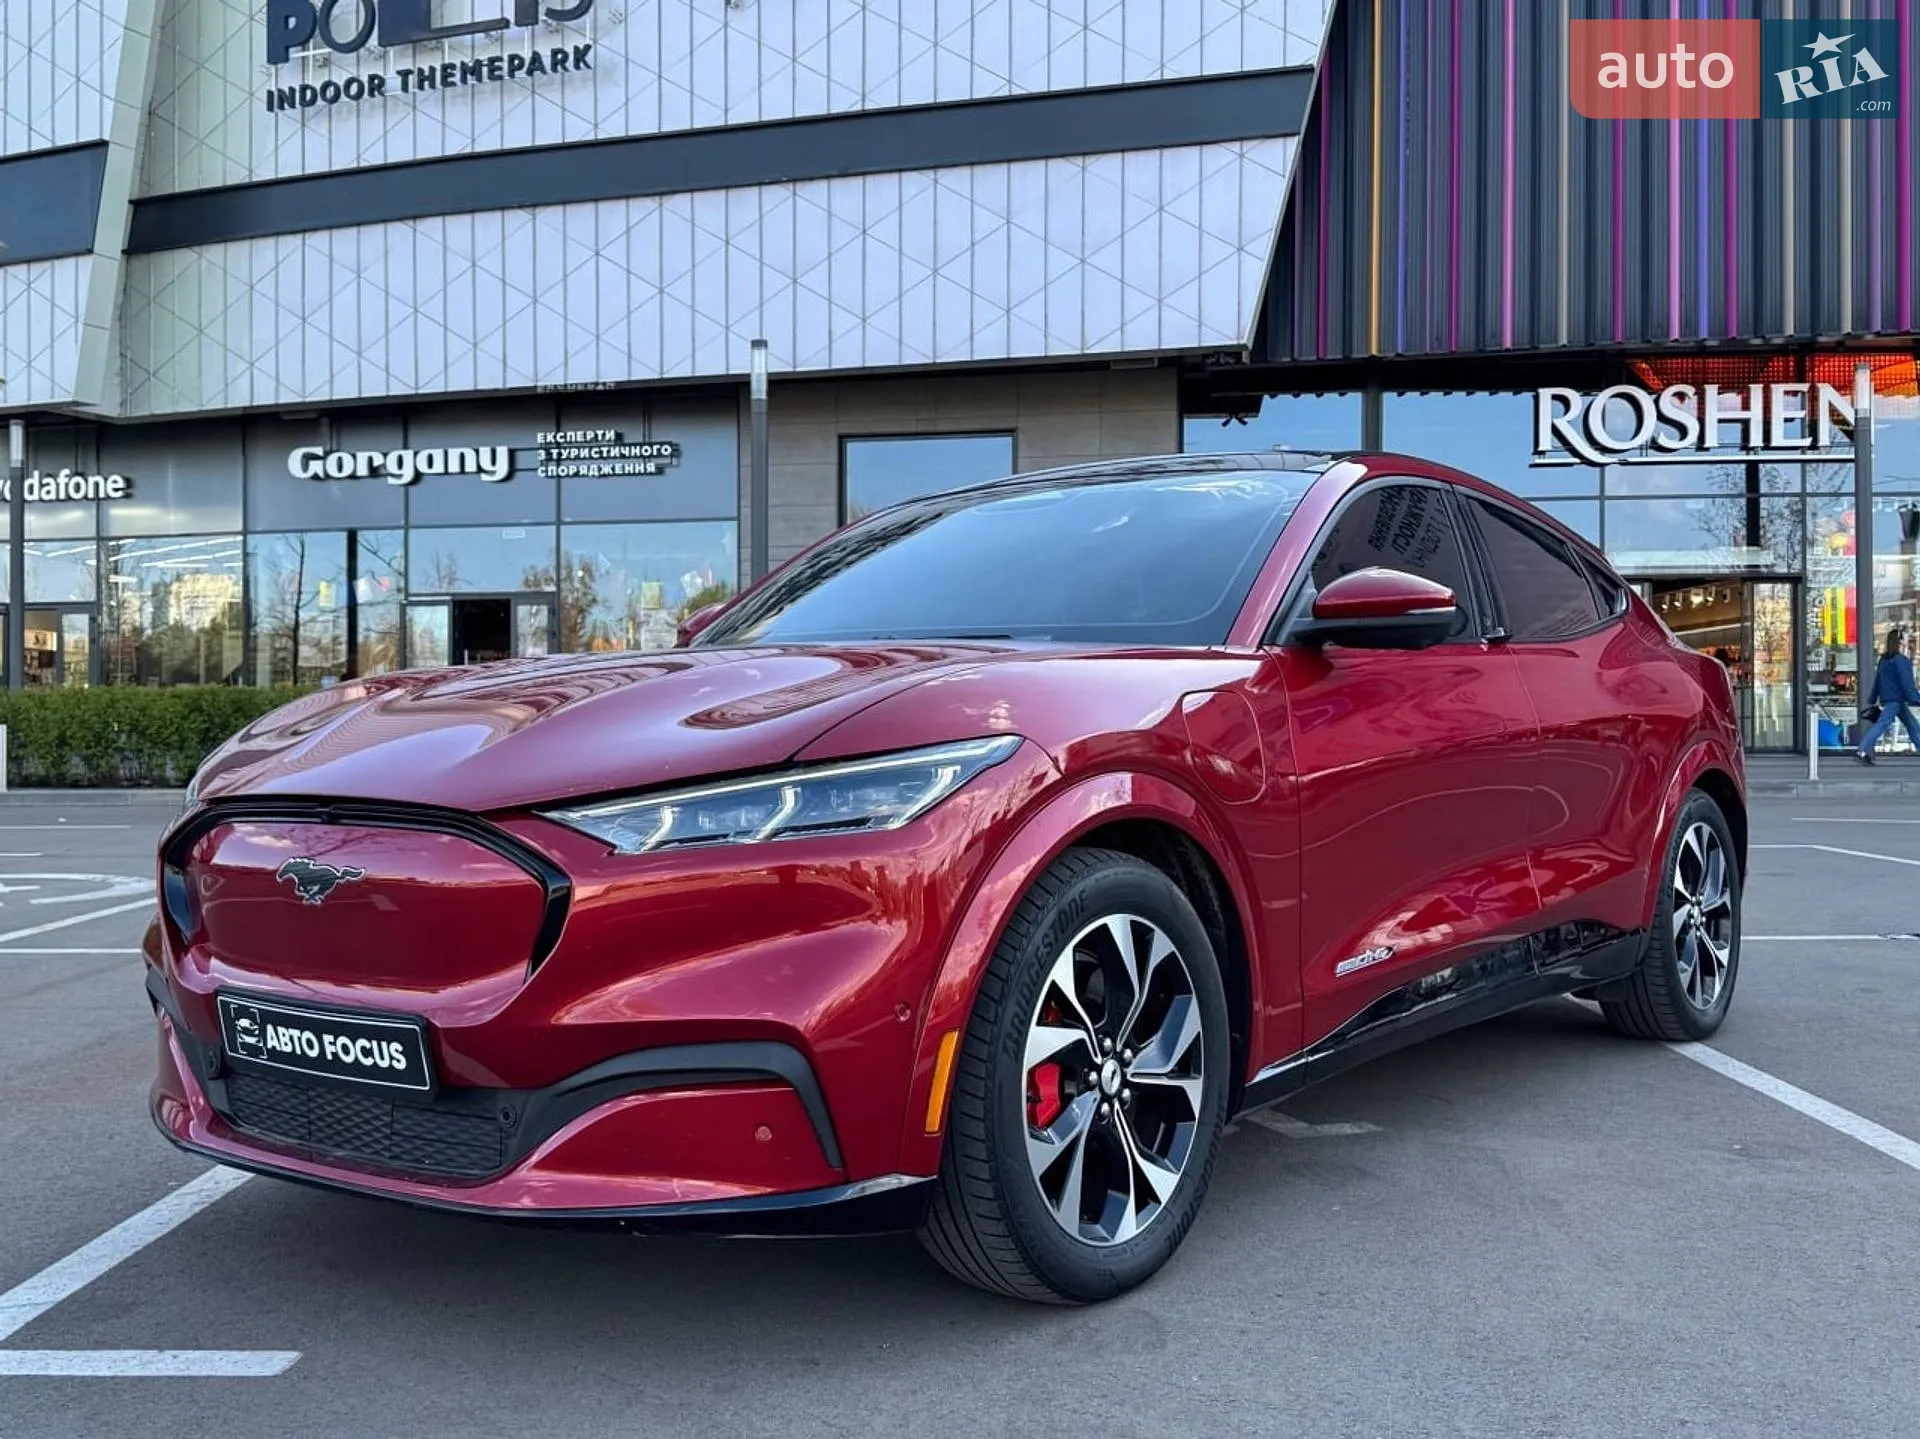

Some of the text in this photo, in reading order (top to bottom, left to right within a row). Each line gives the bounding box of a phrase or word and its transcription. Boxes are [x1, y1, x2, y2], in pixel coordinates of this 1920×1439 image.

[266, 44, 592, 112] INDOOR THEMEPARK
[536, 429, 616, 444] ЕКСПЕРТИ
[1536, 382, 1875, 464] ROSHEN
[287, 444, 513, 485] Gorgany
[537, 462, 656, 477] СПОРЯДЖЕННЯ
[551, 444, 672, 458] ТУРИСТИЧНОГО
[0, 468, 126, 501] dafone
[266, 1024, 407, 1070] АВТО FOCUS
